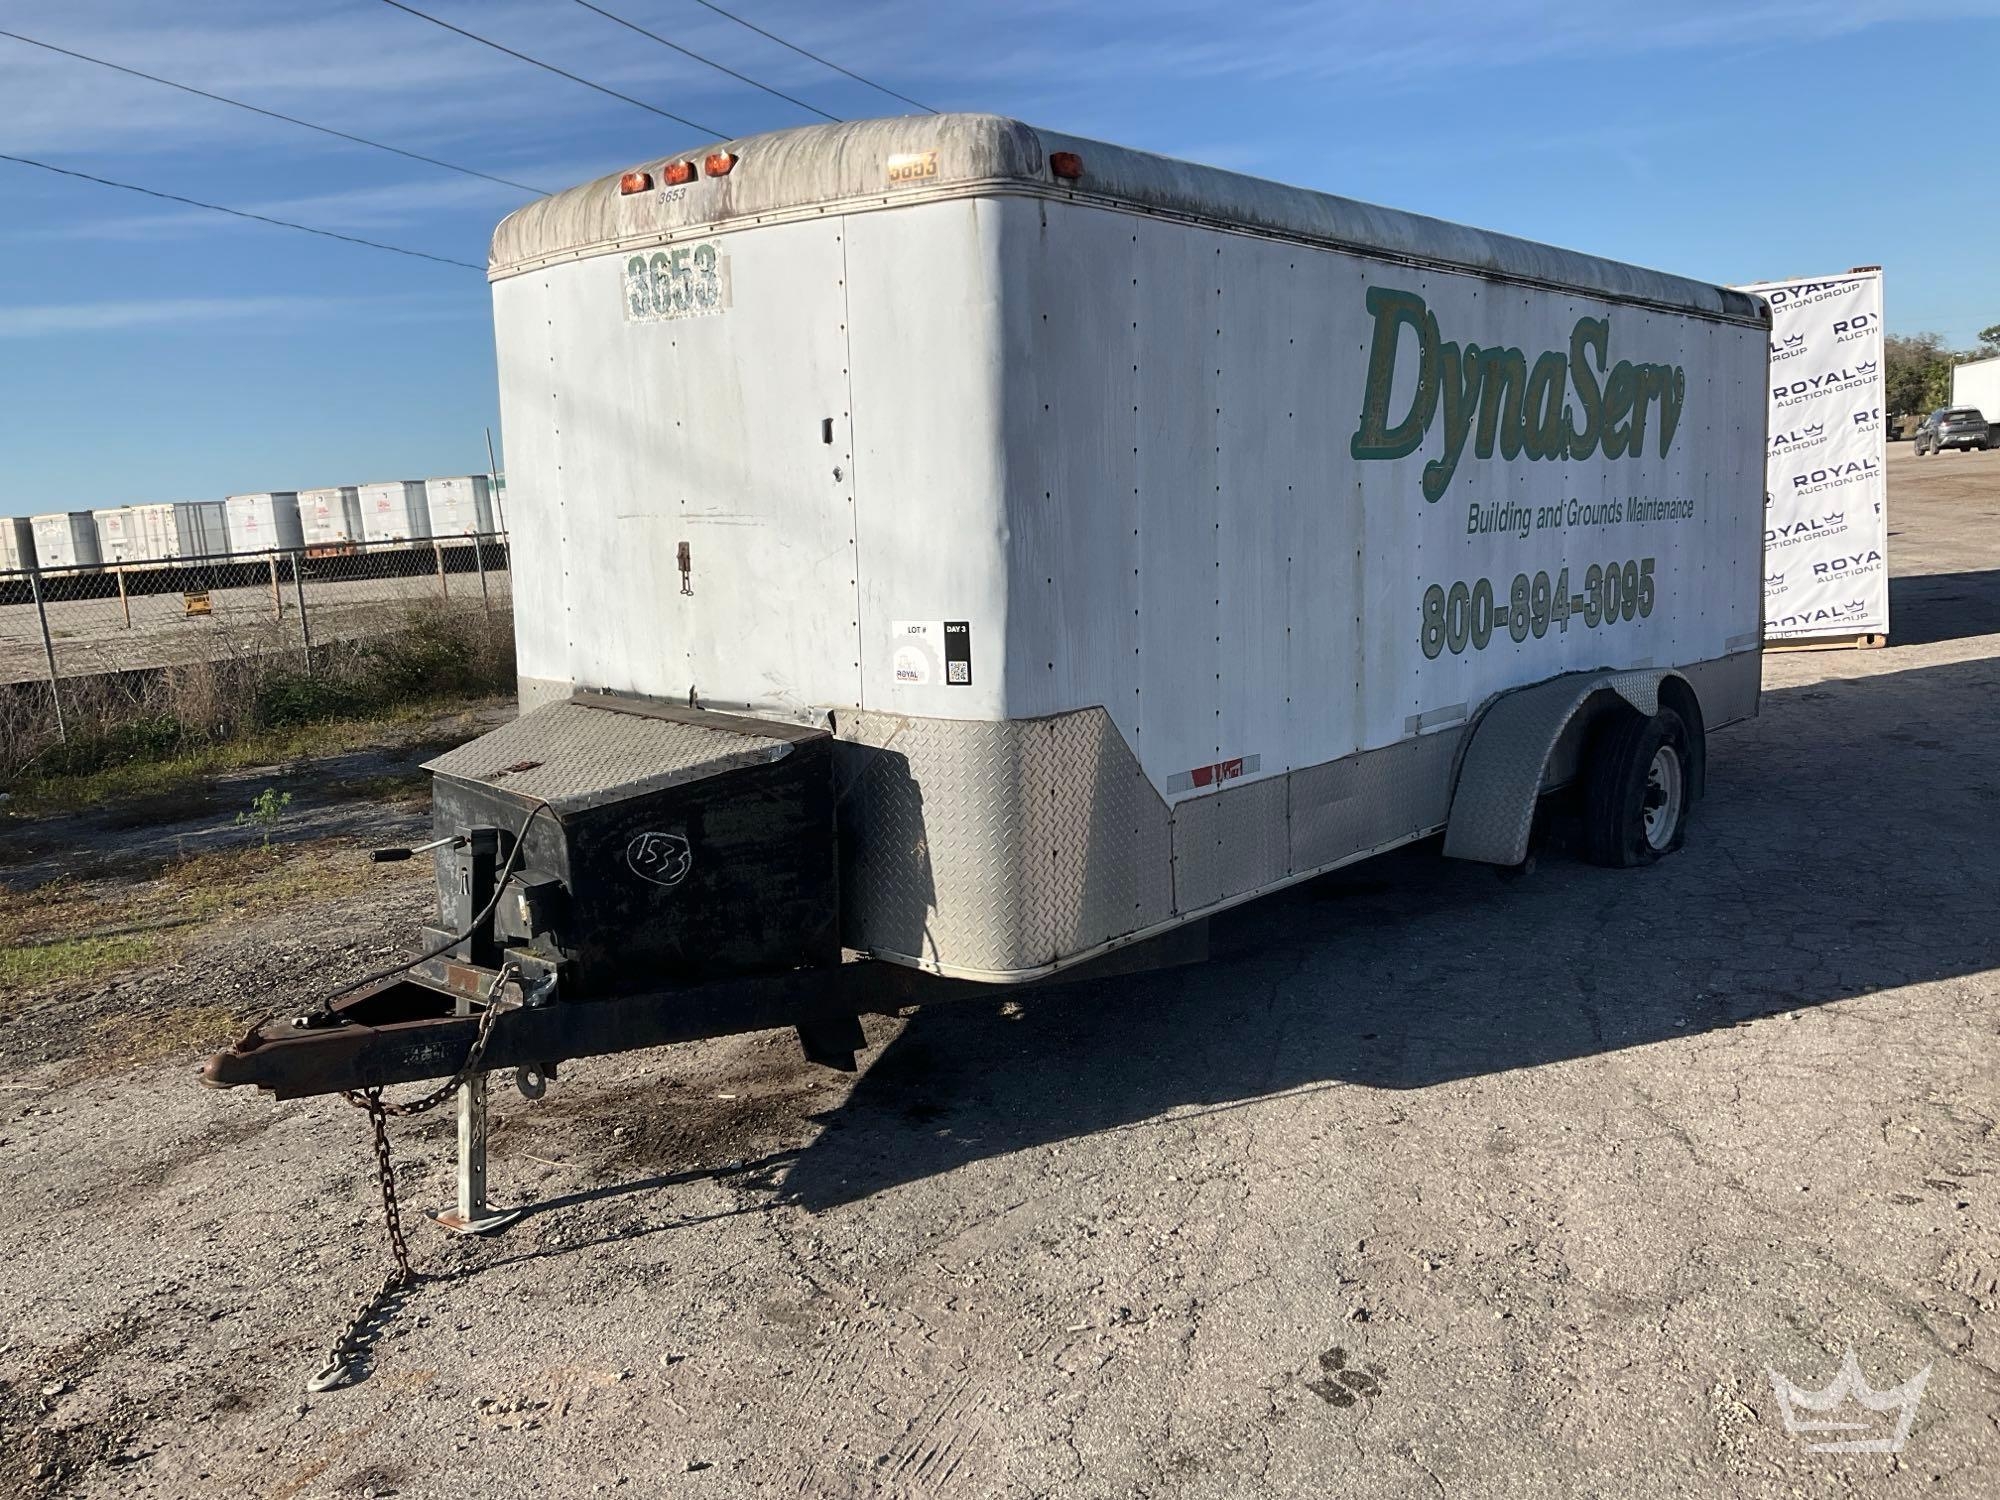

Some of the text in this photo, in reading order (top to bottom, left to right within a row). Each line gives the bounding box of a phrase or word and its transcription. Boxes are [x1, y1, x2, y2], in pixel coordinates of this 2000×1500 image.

[657, 187, 687, 205] 3653
[1814, 283, 1861, 302] GROUP
[1773, 369, 1856, 400] ROYAL
[1350, 286, 1686, 503] DynaServ
[1777, 387, 1833, 409] AUCTION
[1783, 436, 1828, 453] GROUP
[1792, 458, 1877, 488] ROYAL
[1797, 477, 1853, 496] AUCTION
[1467, 495, 1694, 538] Building and Grounds Maintenance
[1803, 525, 1848, 542] GROUP
[1817, 565, 1874, 583] AUCTION
[1421, 558, 1656, 660] 800-894-3095
[907, 626, 921, 634] LOT
[946, 625, 967, 633] DAY 3
